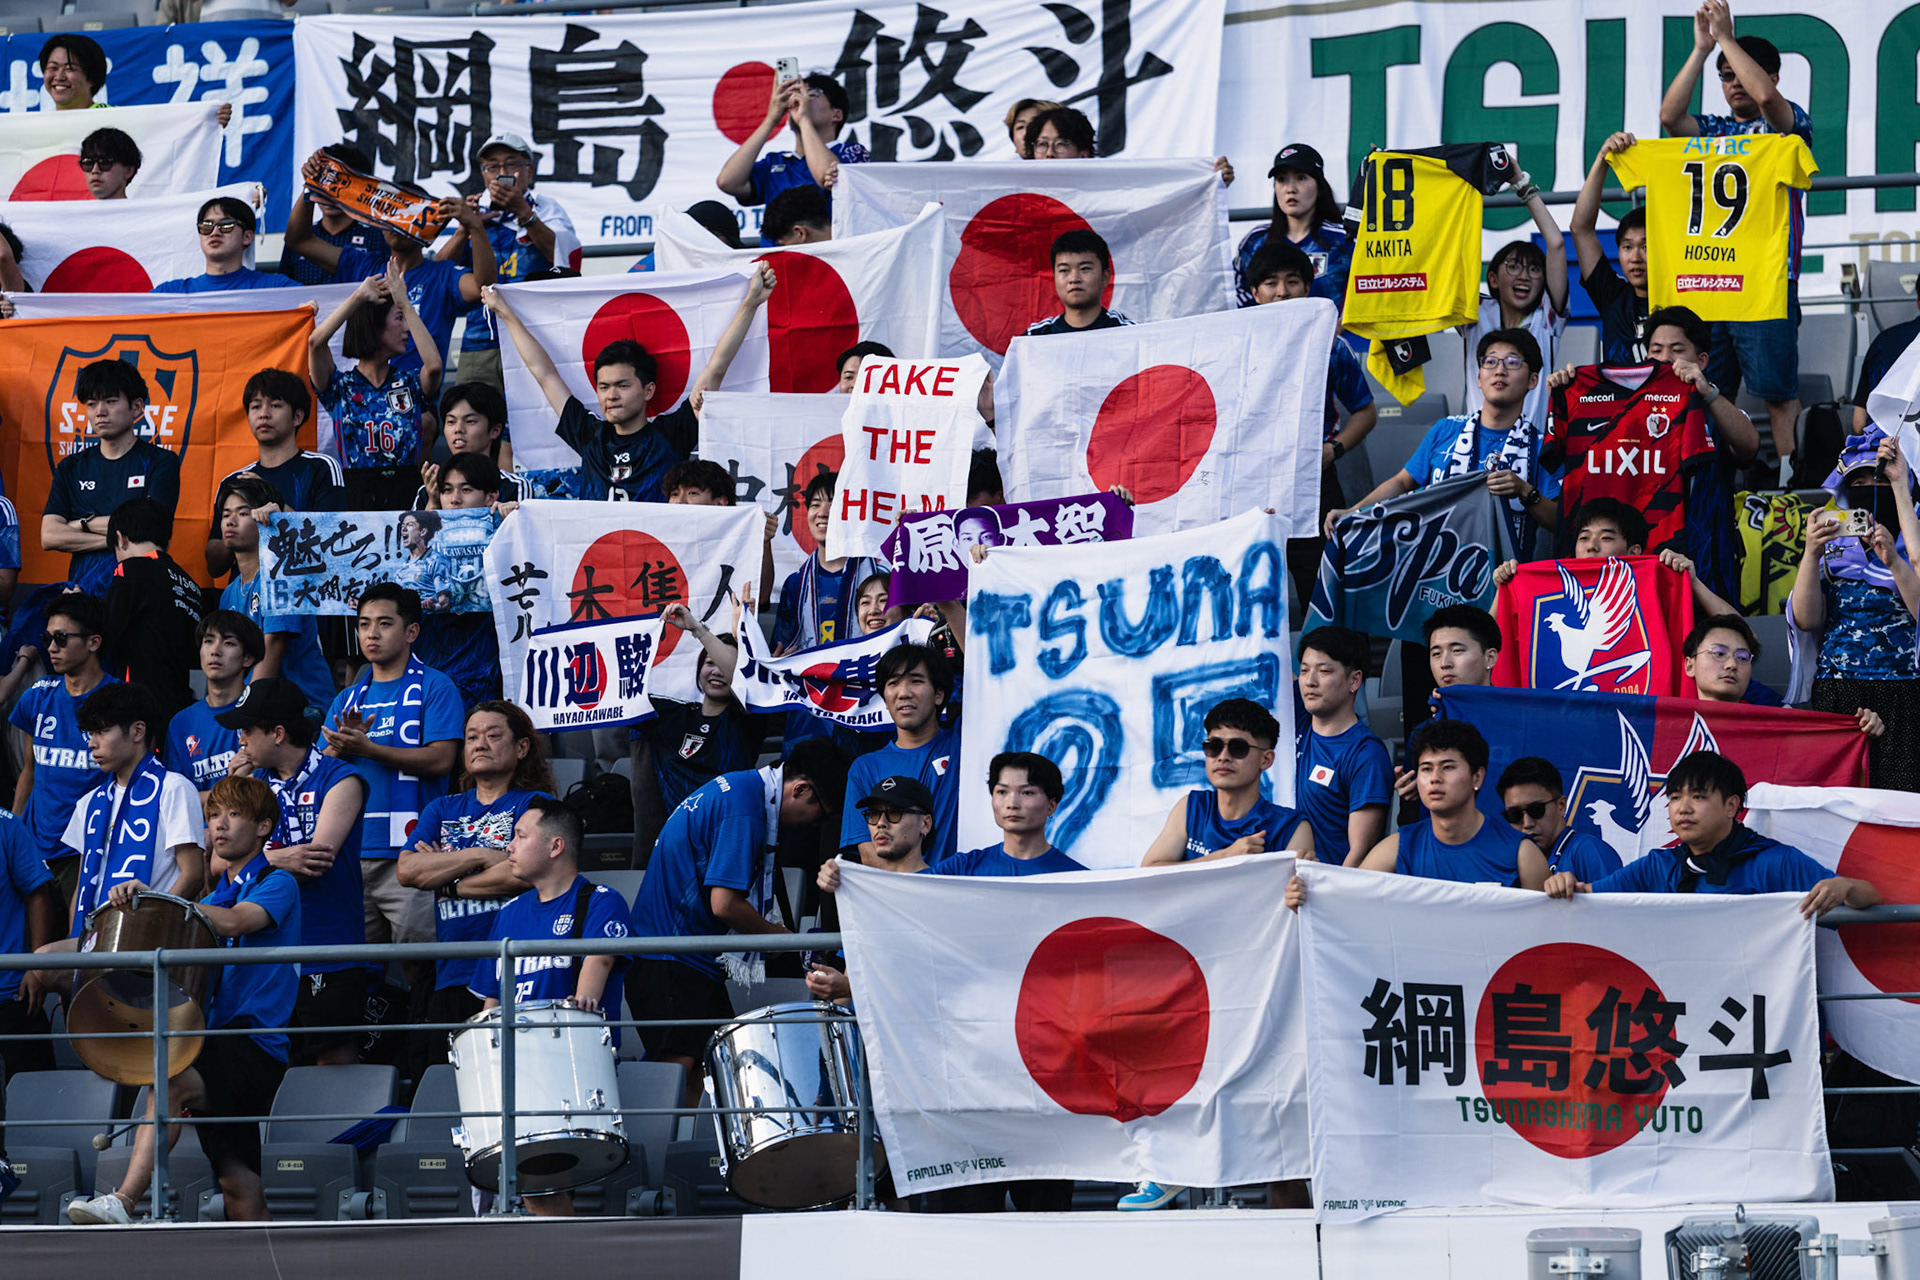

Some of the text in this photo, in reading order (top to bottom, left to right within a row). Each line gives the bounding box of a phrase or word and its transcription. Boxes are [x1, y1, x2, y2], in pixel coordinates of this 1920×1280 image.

[356, 193, 399, 216] SHIMIZU
[1366, 157, 1415, 232] 18
[1681, 160, 1750, 239] 19
[600, 214, 653, 237] FROM
[1365, 238, 1413, 258] KAKITA
[1684, 245, 1736, 263] HOSOYA
[1356, 276, 1426, 290] 日立ビルシステム
[1677, 276, 1741, 290] 日立ビルシステム
[863, 363, 960, 397] TAKE
[1579, 392, 1615, 404] mercari
[1644, 393, 1681, 403] mercari
[59, 402, 178, 436] S-SE
[364, 420, 395, 454] 16
[862, 426, 937, 465] THE
[1587, 445, 1666, 477] LIXIL
[78, 479, 96, 491] Y-3
[969, 541, 1284, 680] TSUNA
[525, 632, 652, 710] 川辺駿
[34, 713, 58, 740] 12
[553, 706, 624, 725] HAYAO KAWABE
[192, 750, 236, 777] ULTR
[1360, 977, 1793, 1100] 綱島悠斗
[1456, 1096, 1703, 1134] TSUNASHIMA YUTO
[907, 1158, 1006, 1182] FAMILIA VERDE
[1323, 1199, 1358, 1210] FAMILIA
